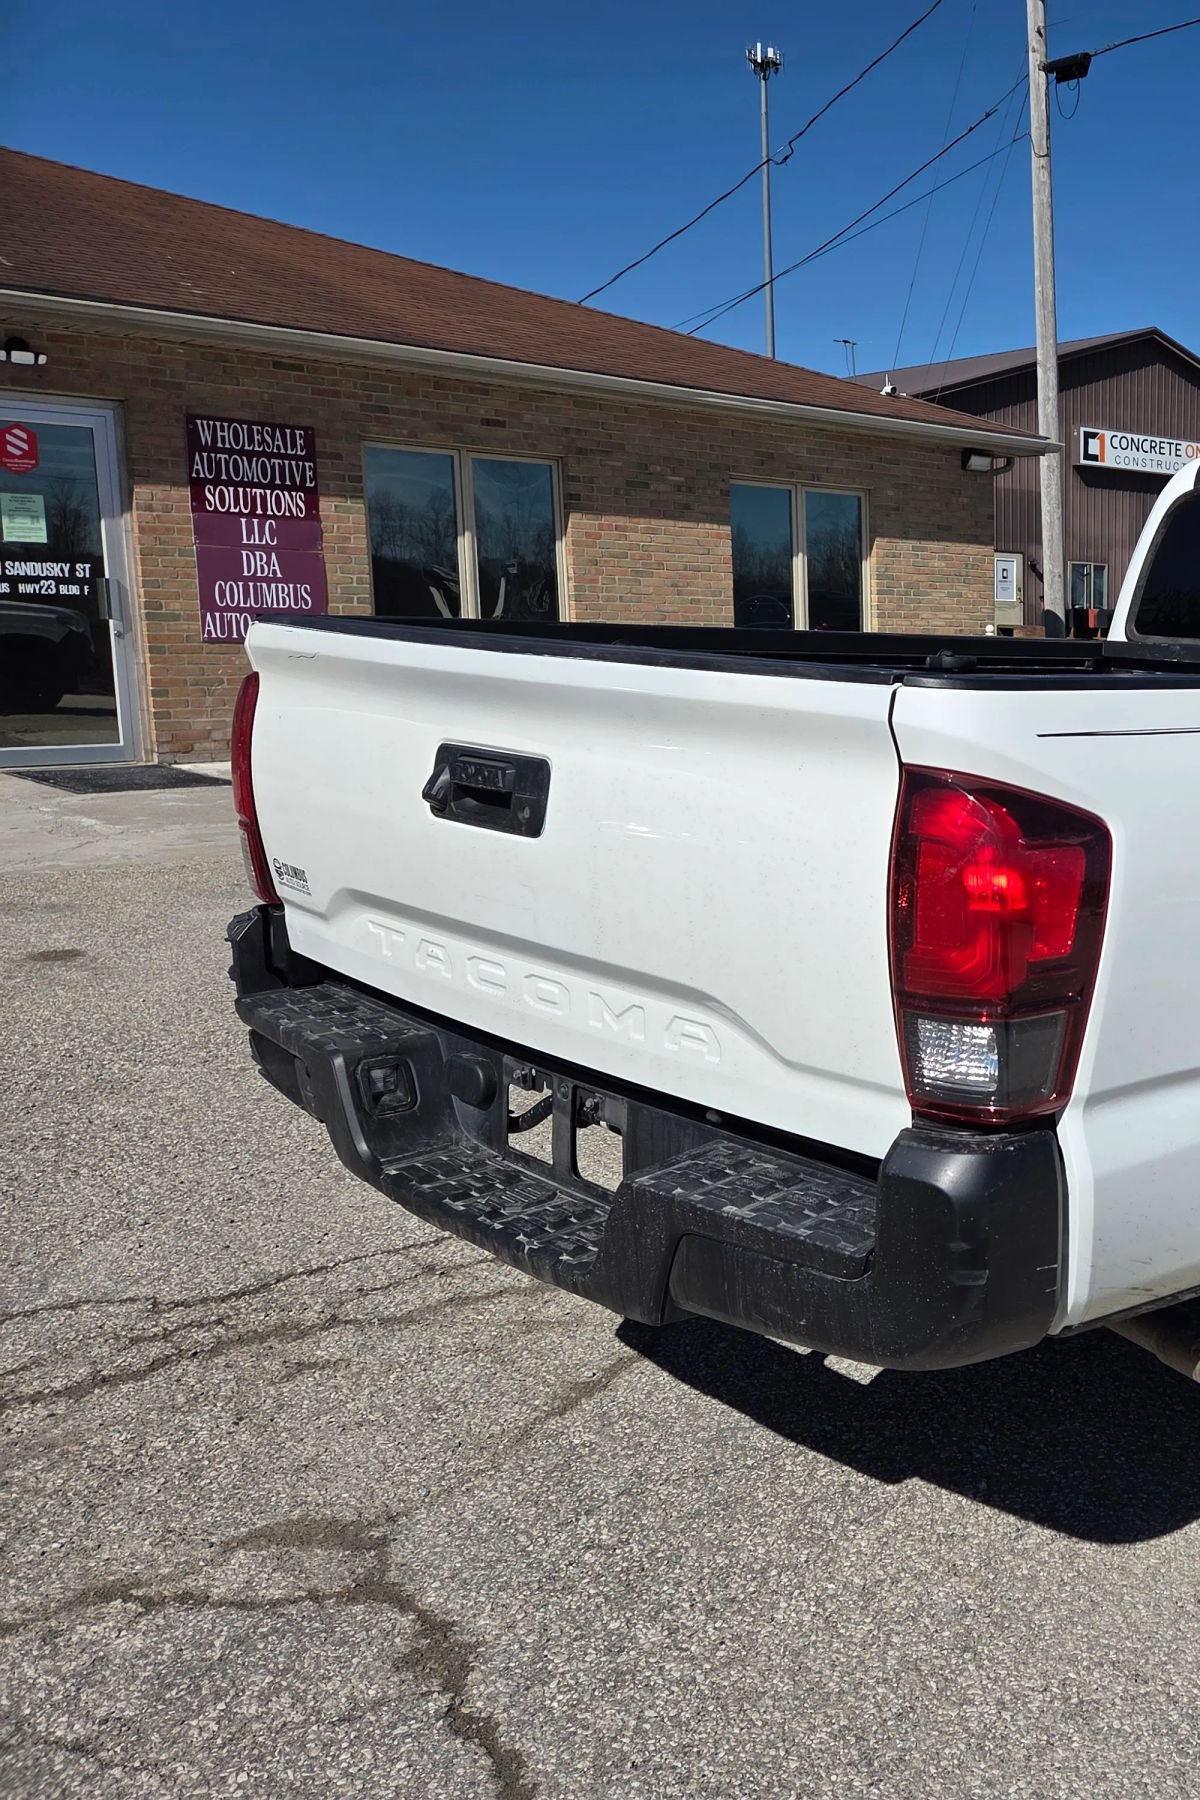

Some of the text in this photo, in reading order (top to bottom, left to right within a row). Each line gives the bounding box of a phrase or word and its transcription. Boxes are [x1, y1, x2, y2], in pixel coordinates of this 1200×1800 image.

[196, 419, 306, 455] WHOLESALE
[1110, 434, 1182, 457] CONCRETE
[192, 451, 316, 487] AUTOMOTIVE
[205, 484, 306, 518] SOLUTIONS
[240, 518, 277, 545] LLC
[5, 560, 70, 578] SANDUSKY
[75, 563, 91, 578] ST
[241, 550, 283, 577] DBA
[59, 584, 80, 595] BLDG
[84, 585, 90, 595] F
[214, 580, 312, 609] COLUMBUS
[203, 612, 252, 639] AUTO
[366, 919, 722, 1065] TACOMA
